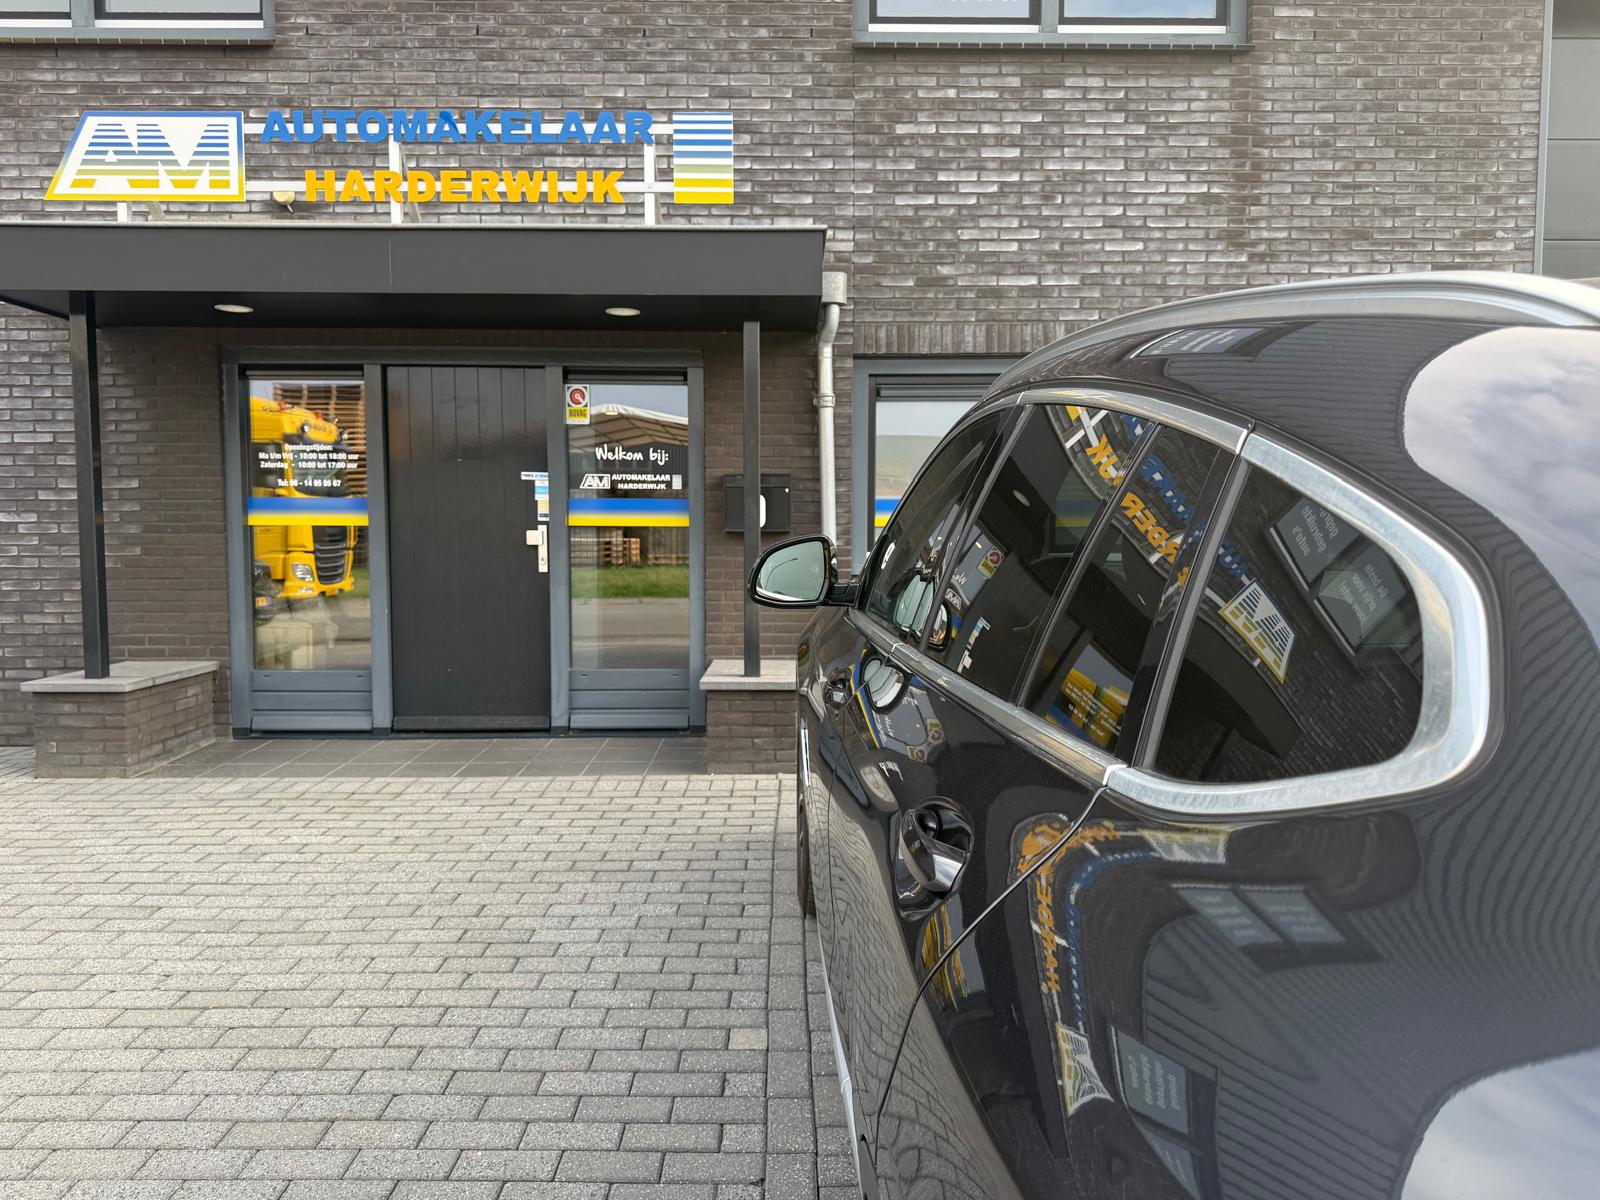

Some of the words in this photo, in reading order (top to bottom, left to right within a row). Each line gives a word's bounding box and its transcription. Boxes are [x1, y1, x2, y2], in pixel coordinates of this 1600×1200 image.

[260, 110, 654, 144] AUTOMAKELAAR
[69, 123, 231, 189] AM
[304, 170, 625, 203] HARDERWIJK
[284, 443, 333, 452] Openingstijden:
[270, 452, 281, 460] t/m
[595, 443, 644, 461] Welkom
[649, 447, 669, 466] bij:
[260, 461, 288, 469] Zaterdag
[298, 461, 316, 469] 10:00
[317, 461, 327, 469] tot
[328, 461, 346, 469] 17:00
[583, 475, 610, 488] AM
[611, 474, 670, 482] AUTOMAKELAAR
